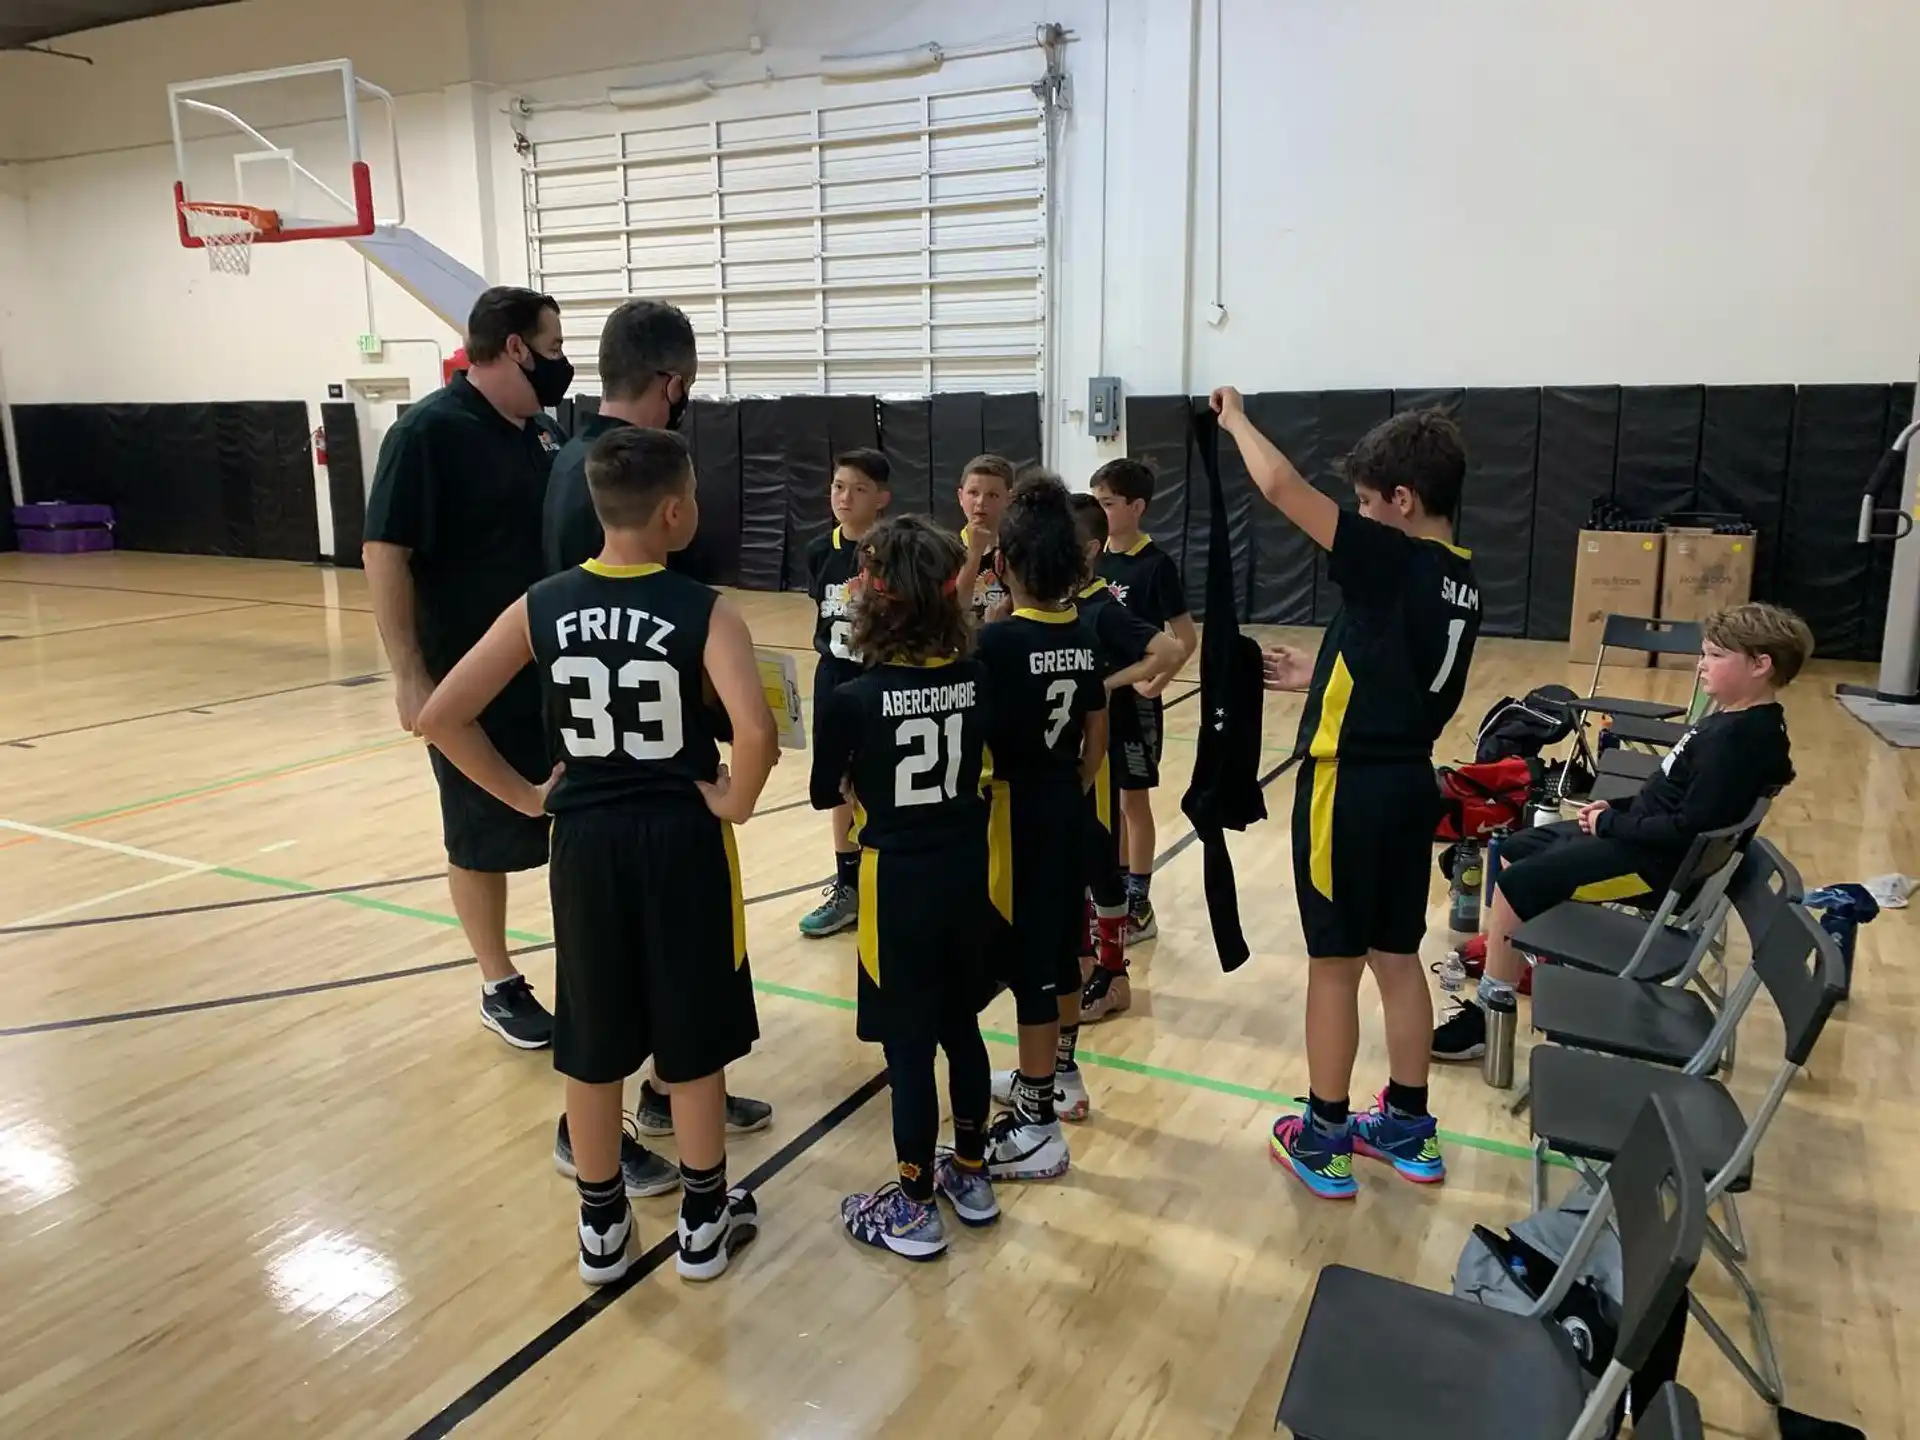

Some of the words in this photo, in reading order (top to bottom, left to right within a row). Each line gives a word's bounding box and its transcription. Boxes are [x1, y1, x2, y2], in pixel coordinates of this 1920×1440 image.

[556, 607, 675, 656] FRITZ
[1029, 648, 1095, 675] GREENE
[1429, 618, 1466, 693] 1
[551, 656, 684, 760] 33
[882, 681, 977, 717] ABERCROMBIE
[1044, 679, 1078, 750] 3
[894, 712, 964, 807] 21
